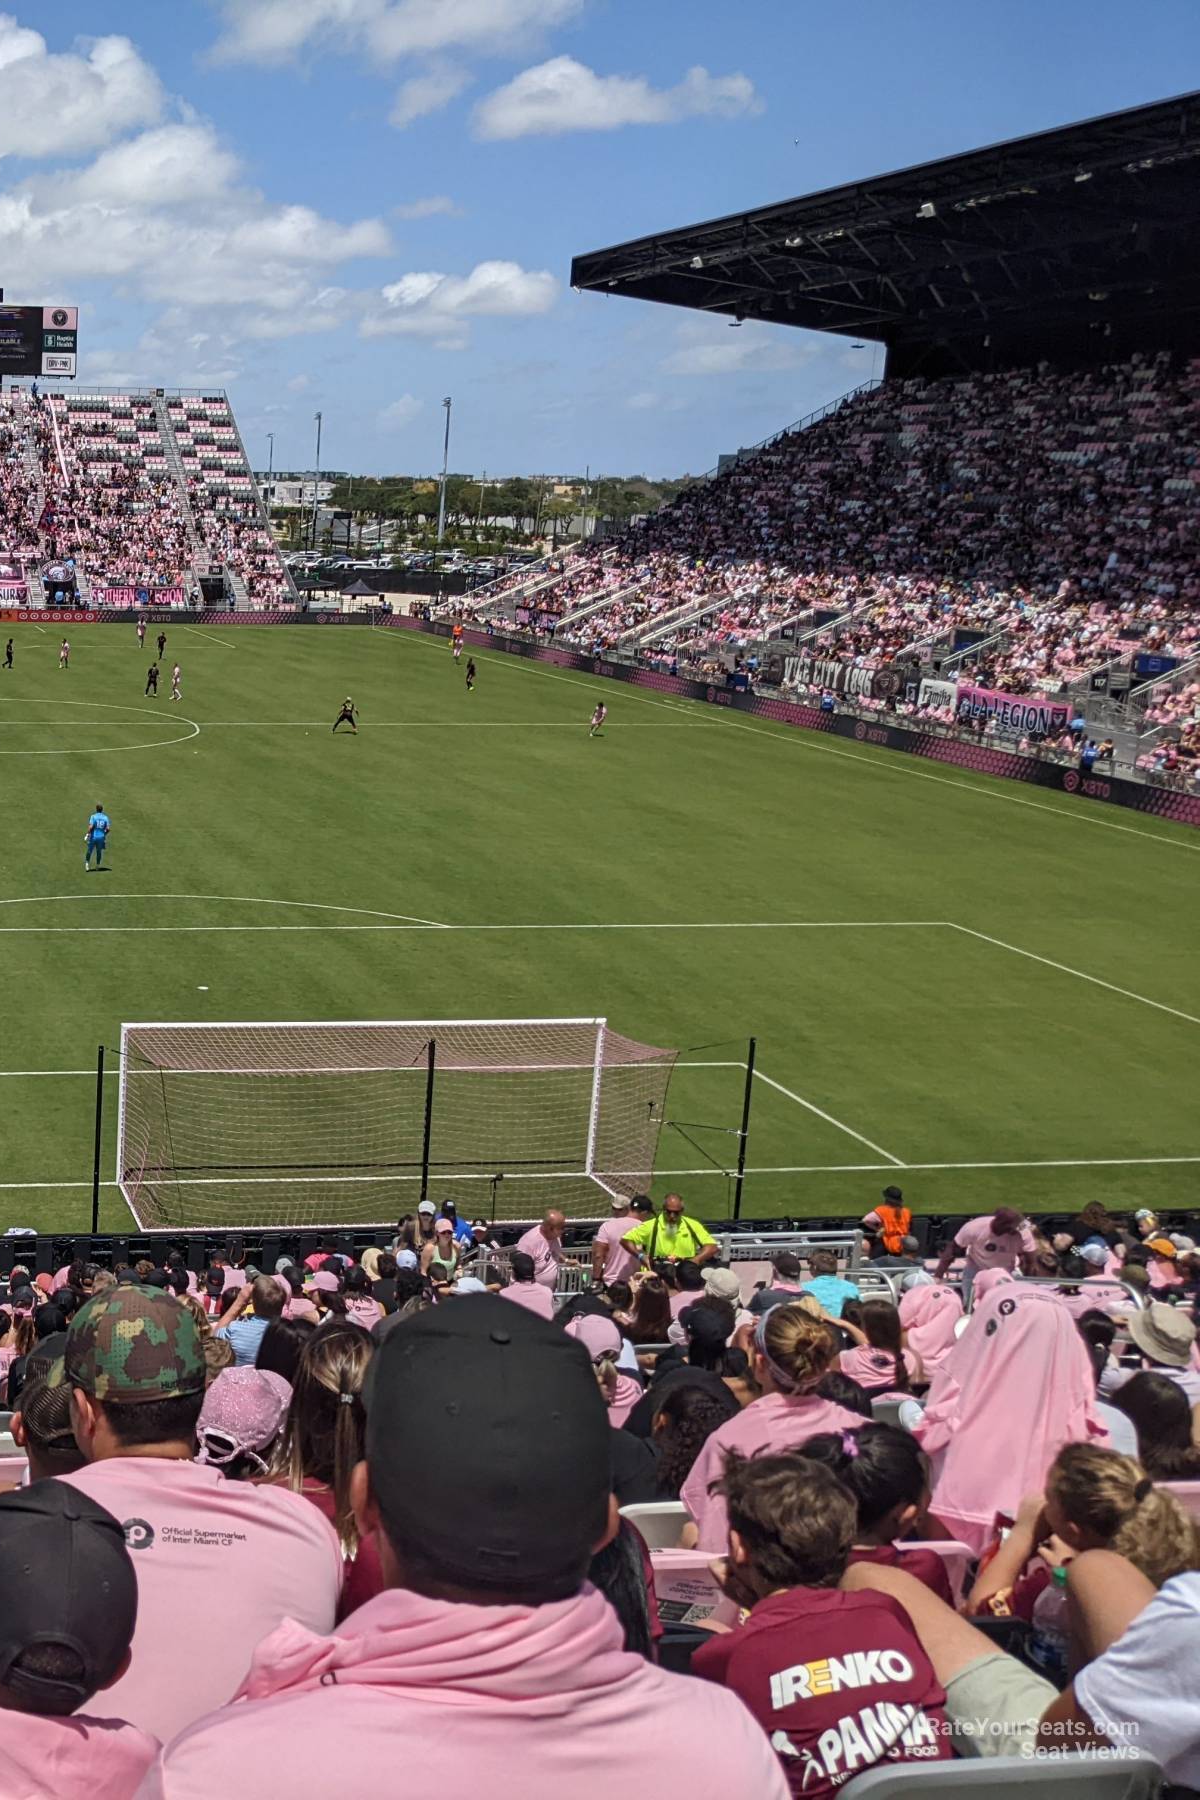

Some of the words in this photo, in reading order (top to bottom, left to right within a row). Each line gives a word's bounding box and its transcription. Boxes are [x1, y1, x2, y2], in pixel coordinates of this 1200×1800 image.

[784, 656, 811, 683] VICE
[813, 661, 844, 690] CITY
[844, 666, 875, 697] 1896
[922, 685, 951, 706] Familia
[970, 693, 989, 720] LA
[992, 696, 1050, 736] LEGION
[1081, 777, 1111, 798] XBTO
[161, 1527, 192, 1538] Official
[194, 1530, 247, 1542] Supermarket
[172, 1536, 191, 1544] Inter
[193, 1537, 219, 1546] Miami
[221, 1539, 233, 1547] CF
[770, 1649, 913, 1710] IRENKO
[817, 1702, 938, 1775] PANNA
[904, 1746, 940, 1759] FOOD
